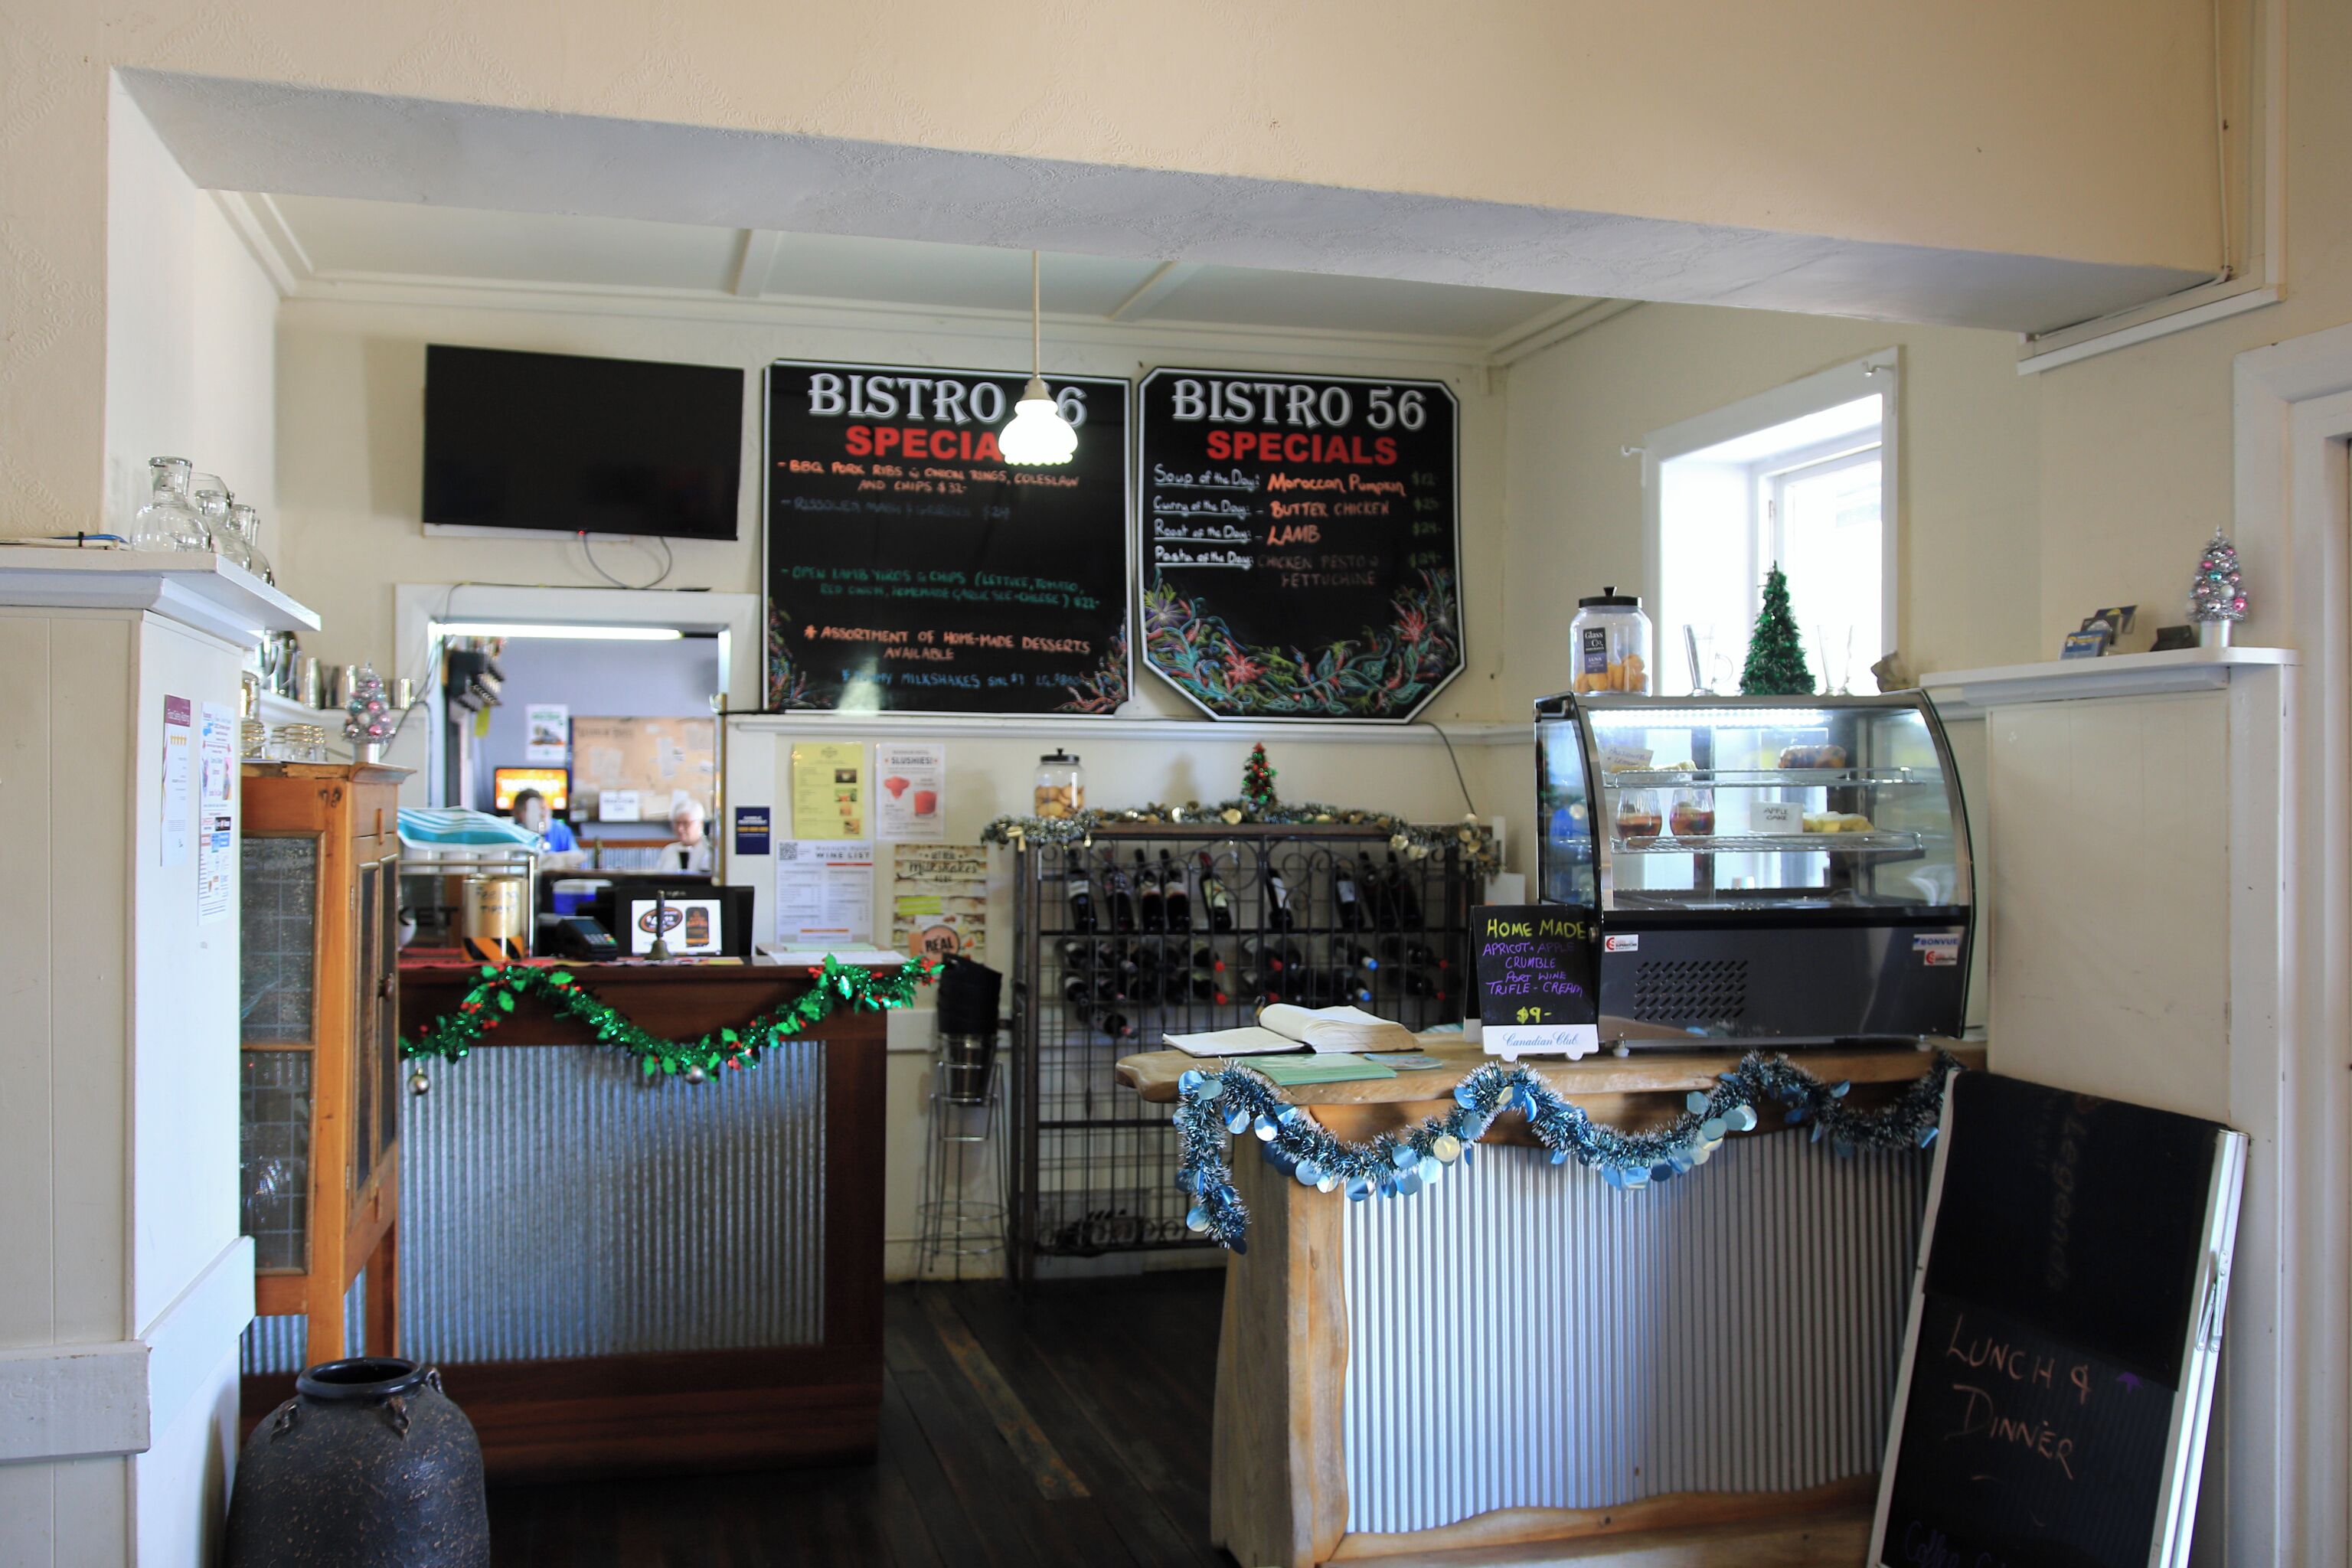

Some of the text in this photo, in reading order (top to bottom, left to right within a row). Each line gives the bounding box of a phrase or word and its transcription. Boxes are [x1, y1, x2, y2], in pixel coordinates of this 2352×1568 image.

[808, 372, 1088, 429] BISTRO 6
[1171, 378, 1426, 430] BISTRO 56
[845, 425, 1004, 462] SPECIA
[1207, 430, 1398, 466] SPECIALS
[789, 460, 825, 474] BBQ
[831, 462, 865, 475] PORK
[873, 463, 903, 477] RIBS
[924, 467, 965, 481] ONION
[1014, 472, 1080, 487] COLESLAW
[1154, 462, 1194, 488] Soup
[1198, 470, 1213, 485] of
[858, 479, 886, 492] AND
[893, 480, 931, 494] CHIPS
[1267, 472, 1406, 497] Moroccan Pumpkin
[1152, 495, 1190, 518] Curry
[1269, 500, 1390, 519] BUTTER CHICKEN
[1154, 518, 1188, 537] Roast
[1266, 524, 1321, 546] LAMB
[1155, 544, 1194, 563] Pasta
[1256, 554, 1313, 570] CHICKEN
[1321, 553, 1366, 569] PESTO
[792, 567, 826, 580] OPEN
[929, 569, 965, 585] CHIPS
[820, 583, 843, 595] RED
[821, 626, 1091, 654] ASSORTMENT OF HOME-MADE DESSERTS
[884, 647, 955, 661] AVAILABLE
[900, 672, 981, 688] MILKSHAKES
[1486, 919, 1587, 939] HOME MADE
[925, 936, 952, 952] REAL
[1482, 942, 1530, 956] APRICOT
[1537, 942, 1574, 954] APPLE
[1505, 956, 1556, 969] CRUMBLE
[1505, 970, 1566, 982] PORT WINE
[1485, 981, 1530, 995] TRIFLE
[1543, 982, 1583, 998] CREAM
[1503, 1031, 1579, 1047] Canadian Club
[1946, 1314, 2055, 1389] LUNCH
[1944, 1383, 2074, 1481] DINNER
